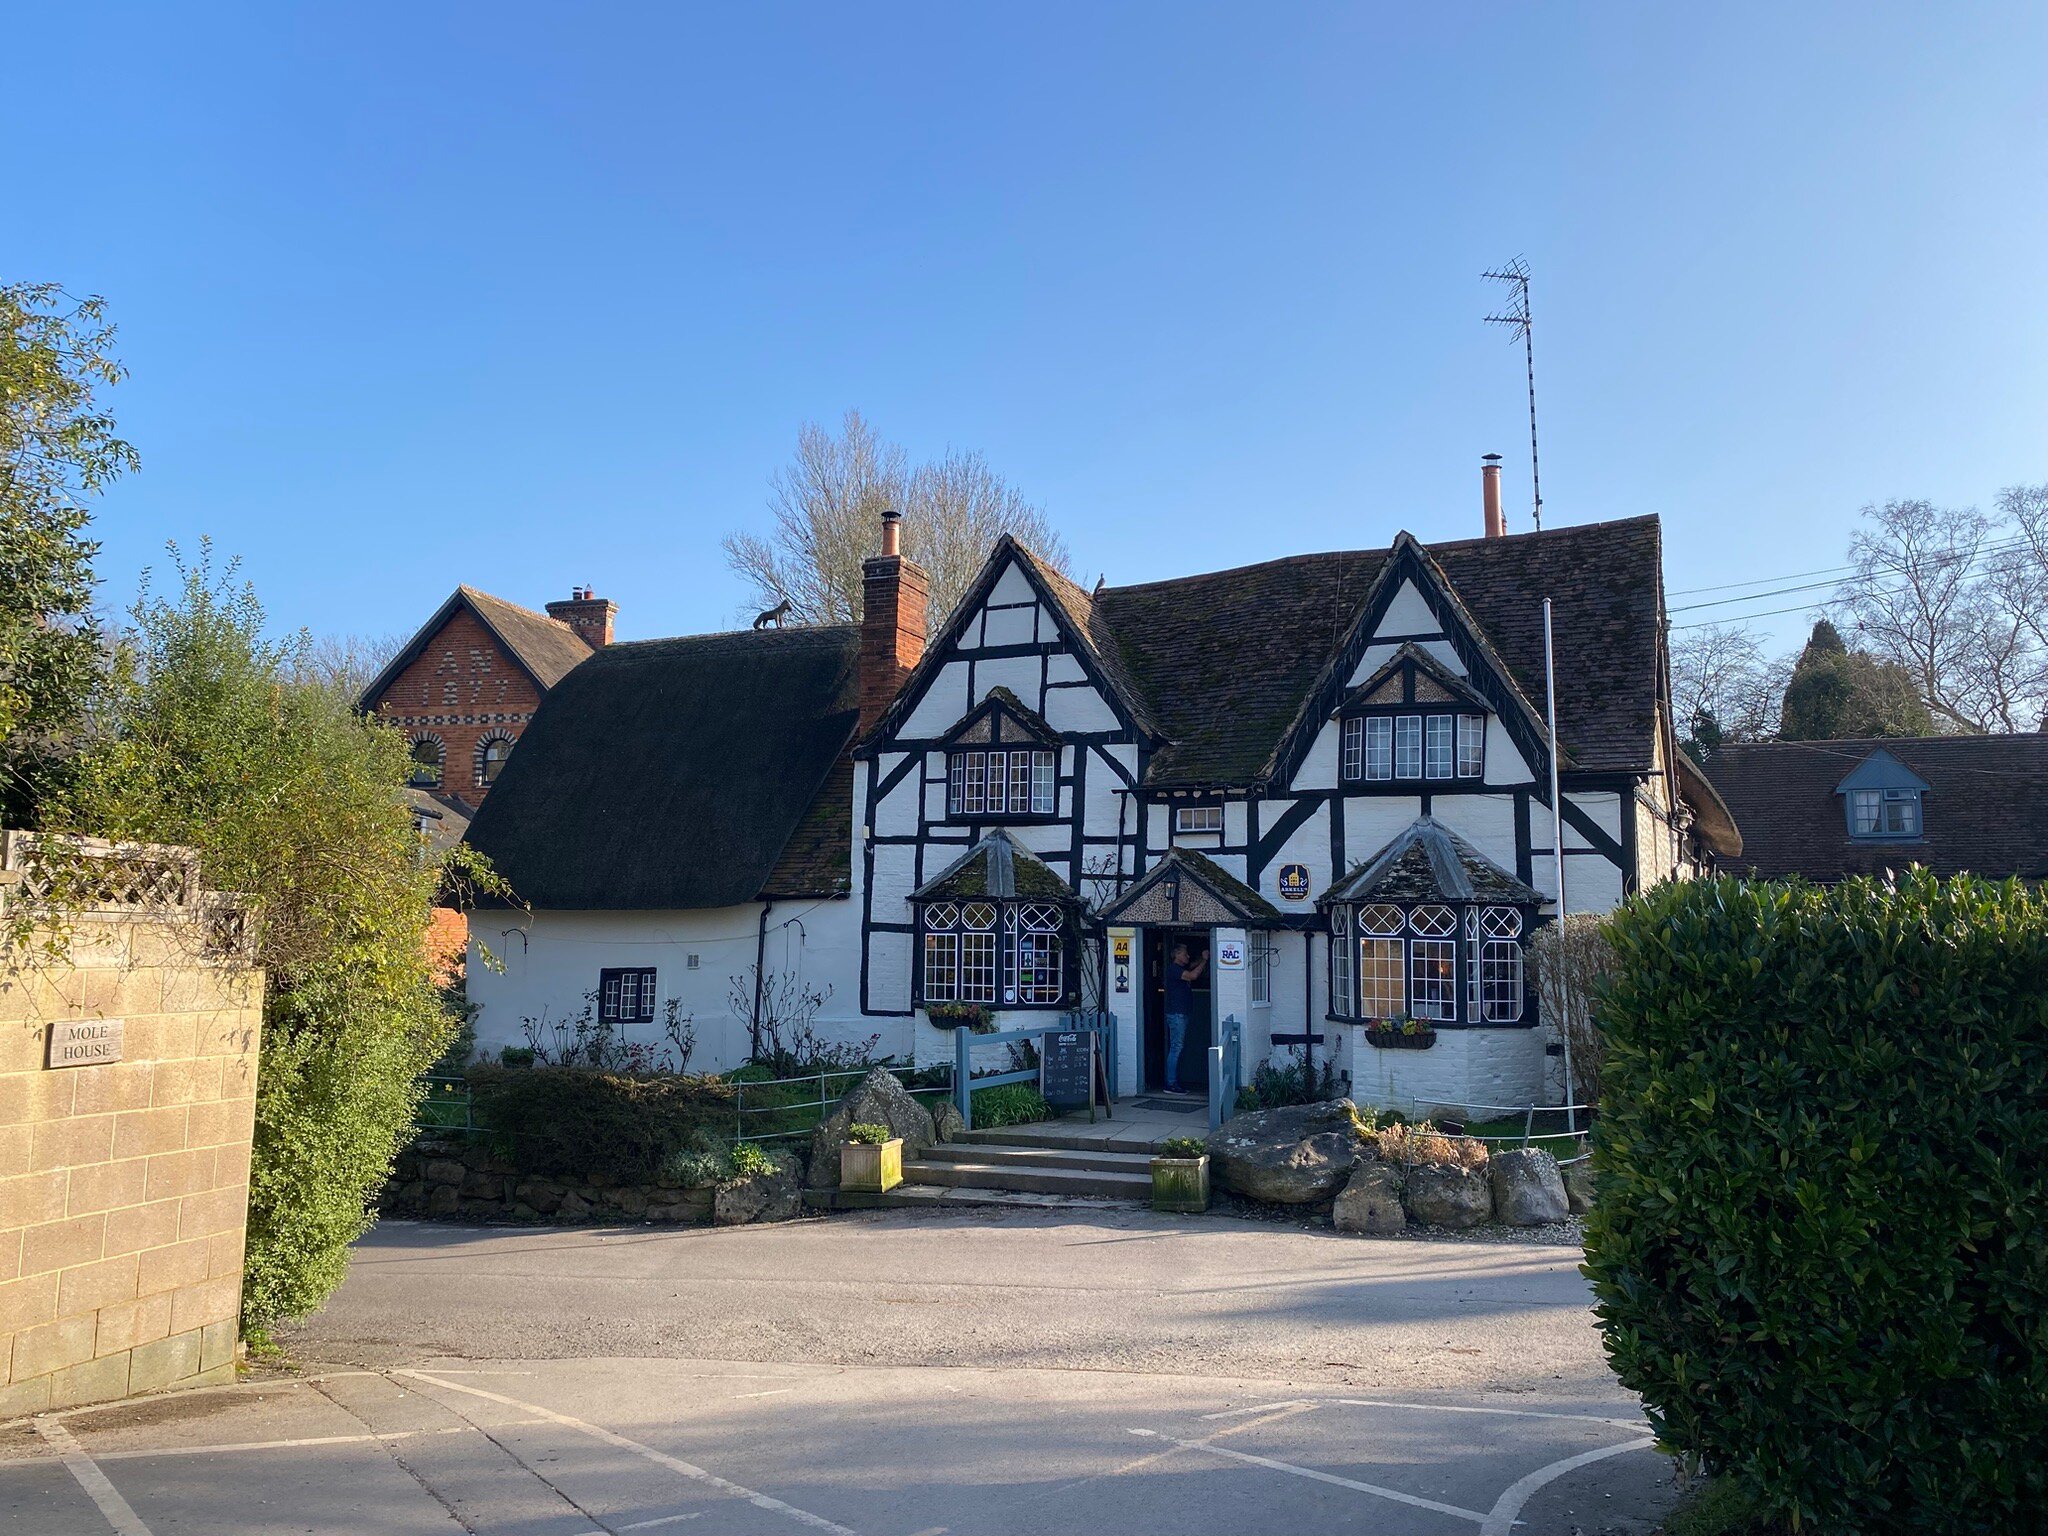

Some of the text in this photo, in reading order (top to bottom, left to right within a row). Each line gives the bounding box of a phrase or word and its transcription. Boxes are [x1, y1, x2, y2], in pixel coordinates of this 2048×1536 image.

[422, 679, 508, 705] 1877
[1115, 942, 1128, 951] AA
[1221, 950, 1240, 959] RAC
[69, 1026, 108, 1040] MOLE
[64, 1044, 110, 1059] HOUSE
